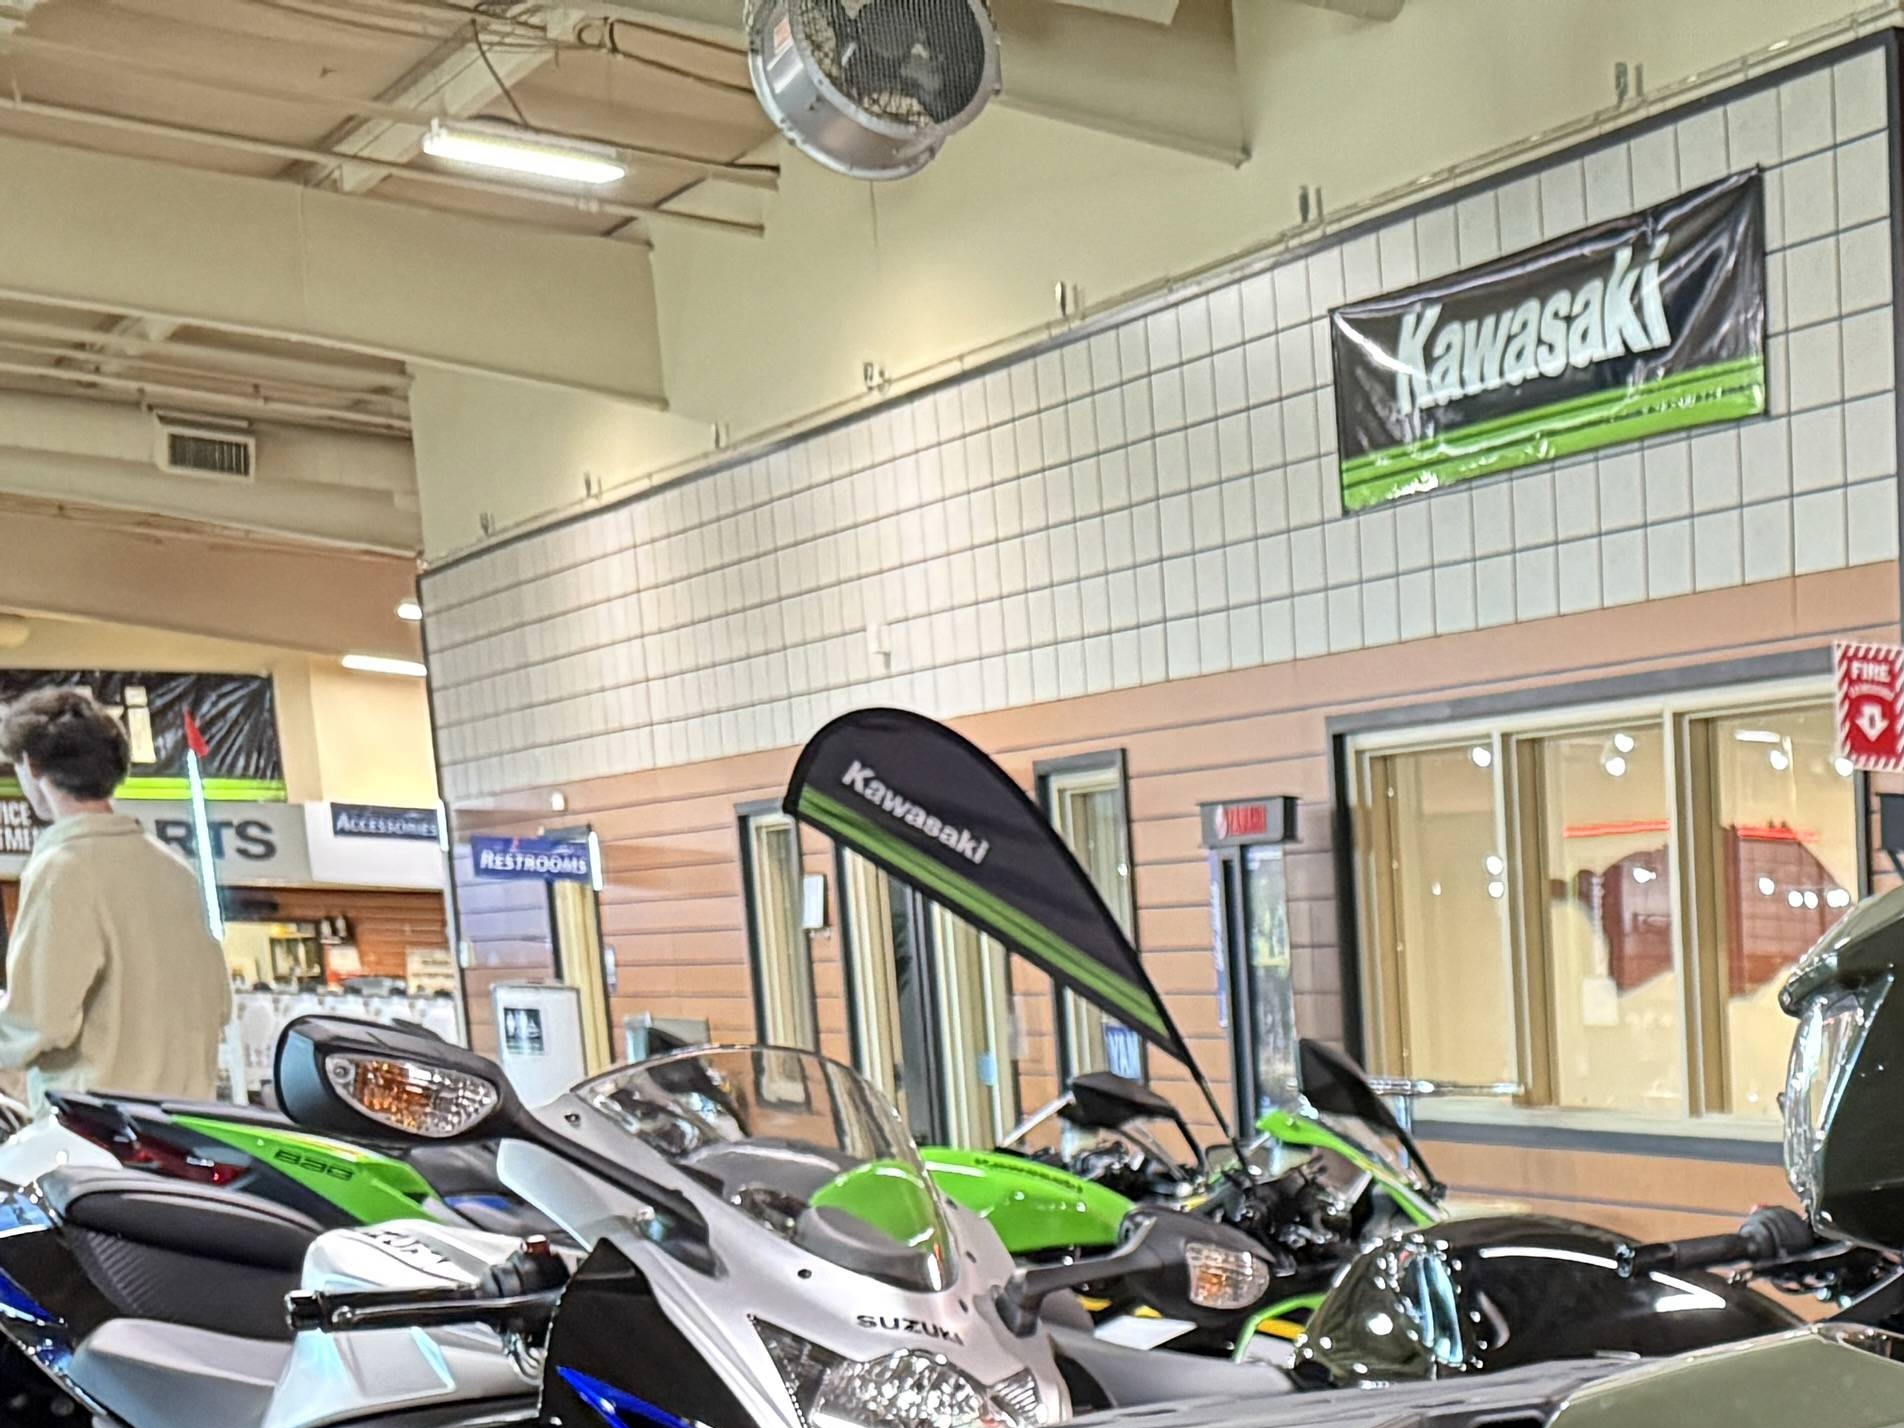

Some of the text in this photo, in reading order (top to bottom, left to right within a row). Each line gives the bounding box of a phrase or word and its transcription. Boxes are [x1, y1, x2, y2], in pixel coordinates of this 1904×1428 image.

[1398, 233, 1671, 412] Kawasaki
[1851, 661, 1890, 682] FIRE
[842, 760, 989, 864] Kawasaki
[480, 850, 587, 875] RESTROOMS
